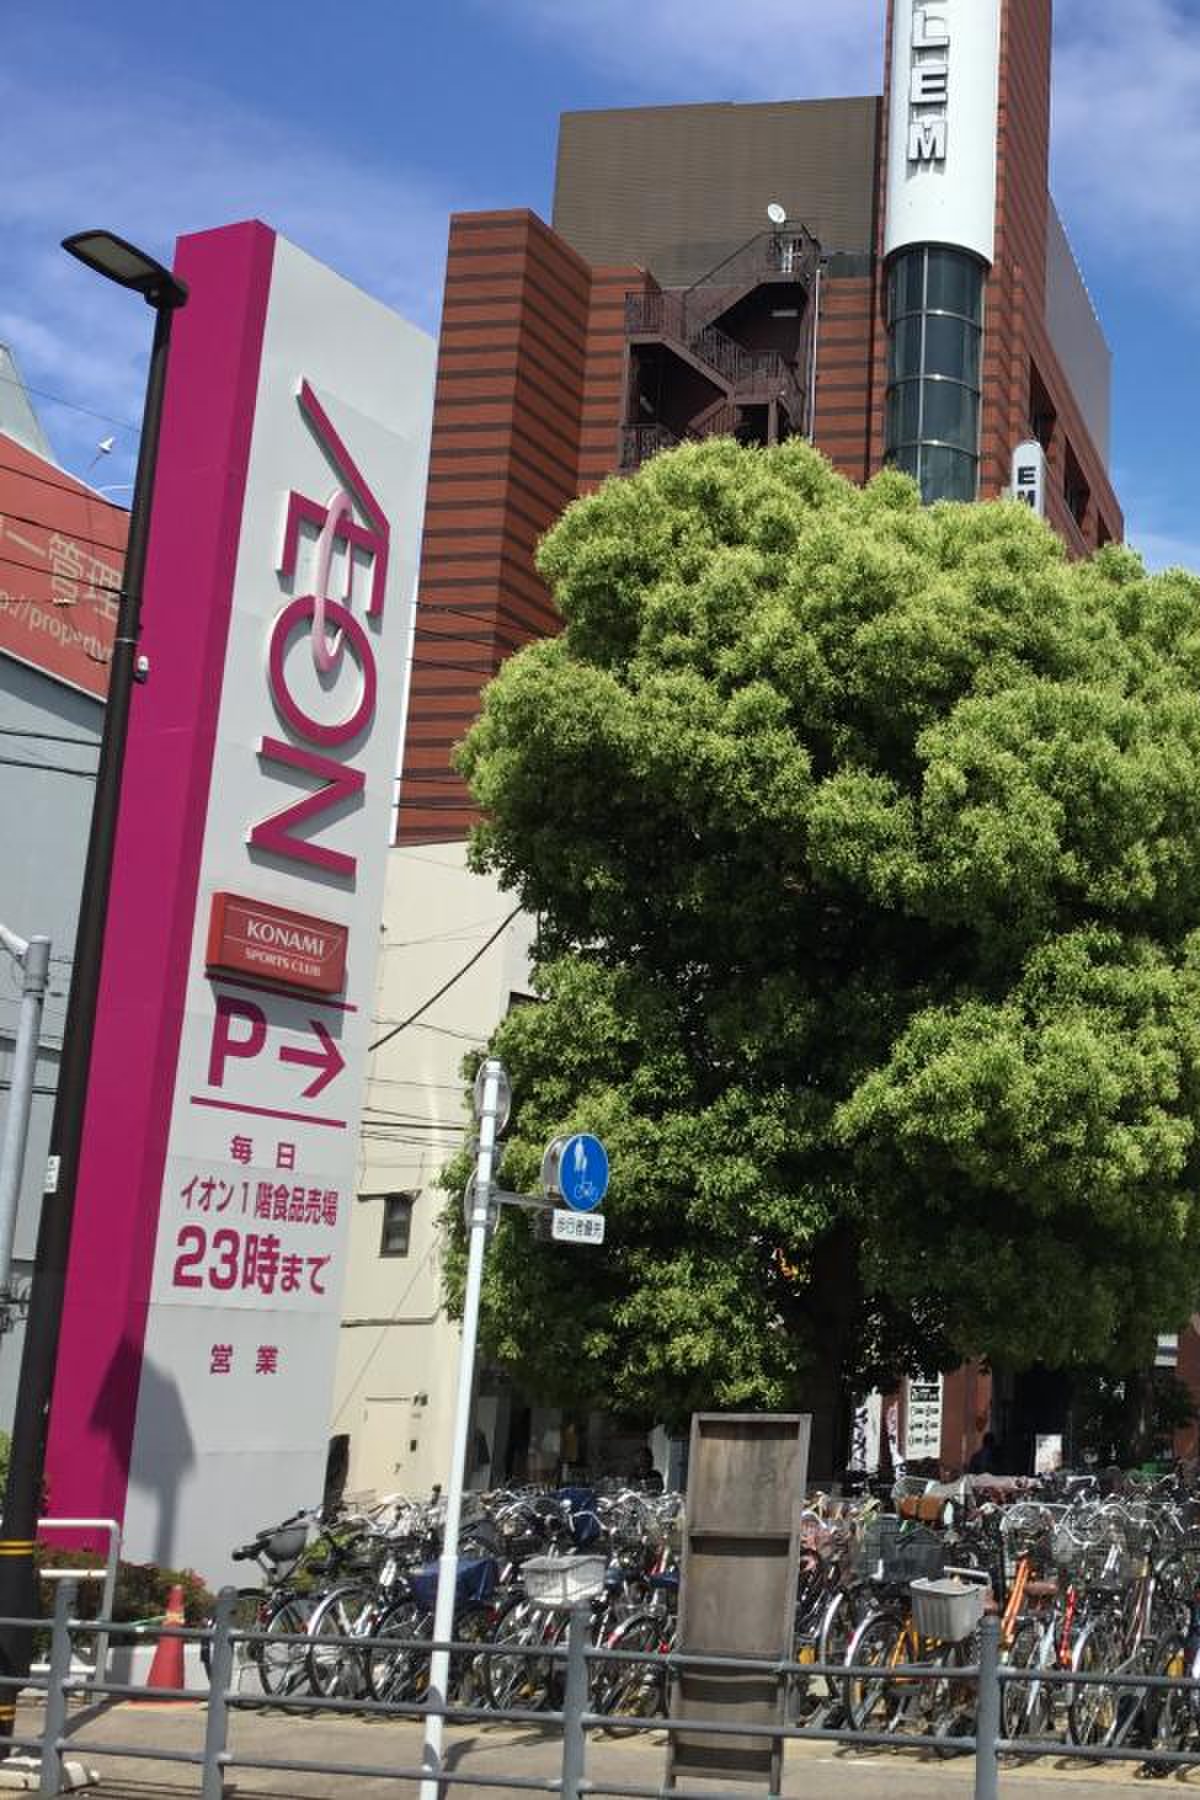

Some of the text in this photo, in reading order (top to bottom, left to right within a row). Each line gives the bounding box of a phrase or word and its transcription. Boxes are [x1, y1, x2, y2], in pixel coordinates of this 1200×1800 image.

[244, 948, 321, 977] SPORTS CLUB
[246, 919, 325, 957] KONAMI
[207, 994, 267, 1088] P
[172, 1224, 332, 1295] 23時まで
